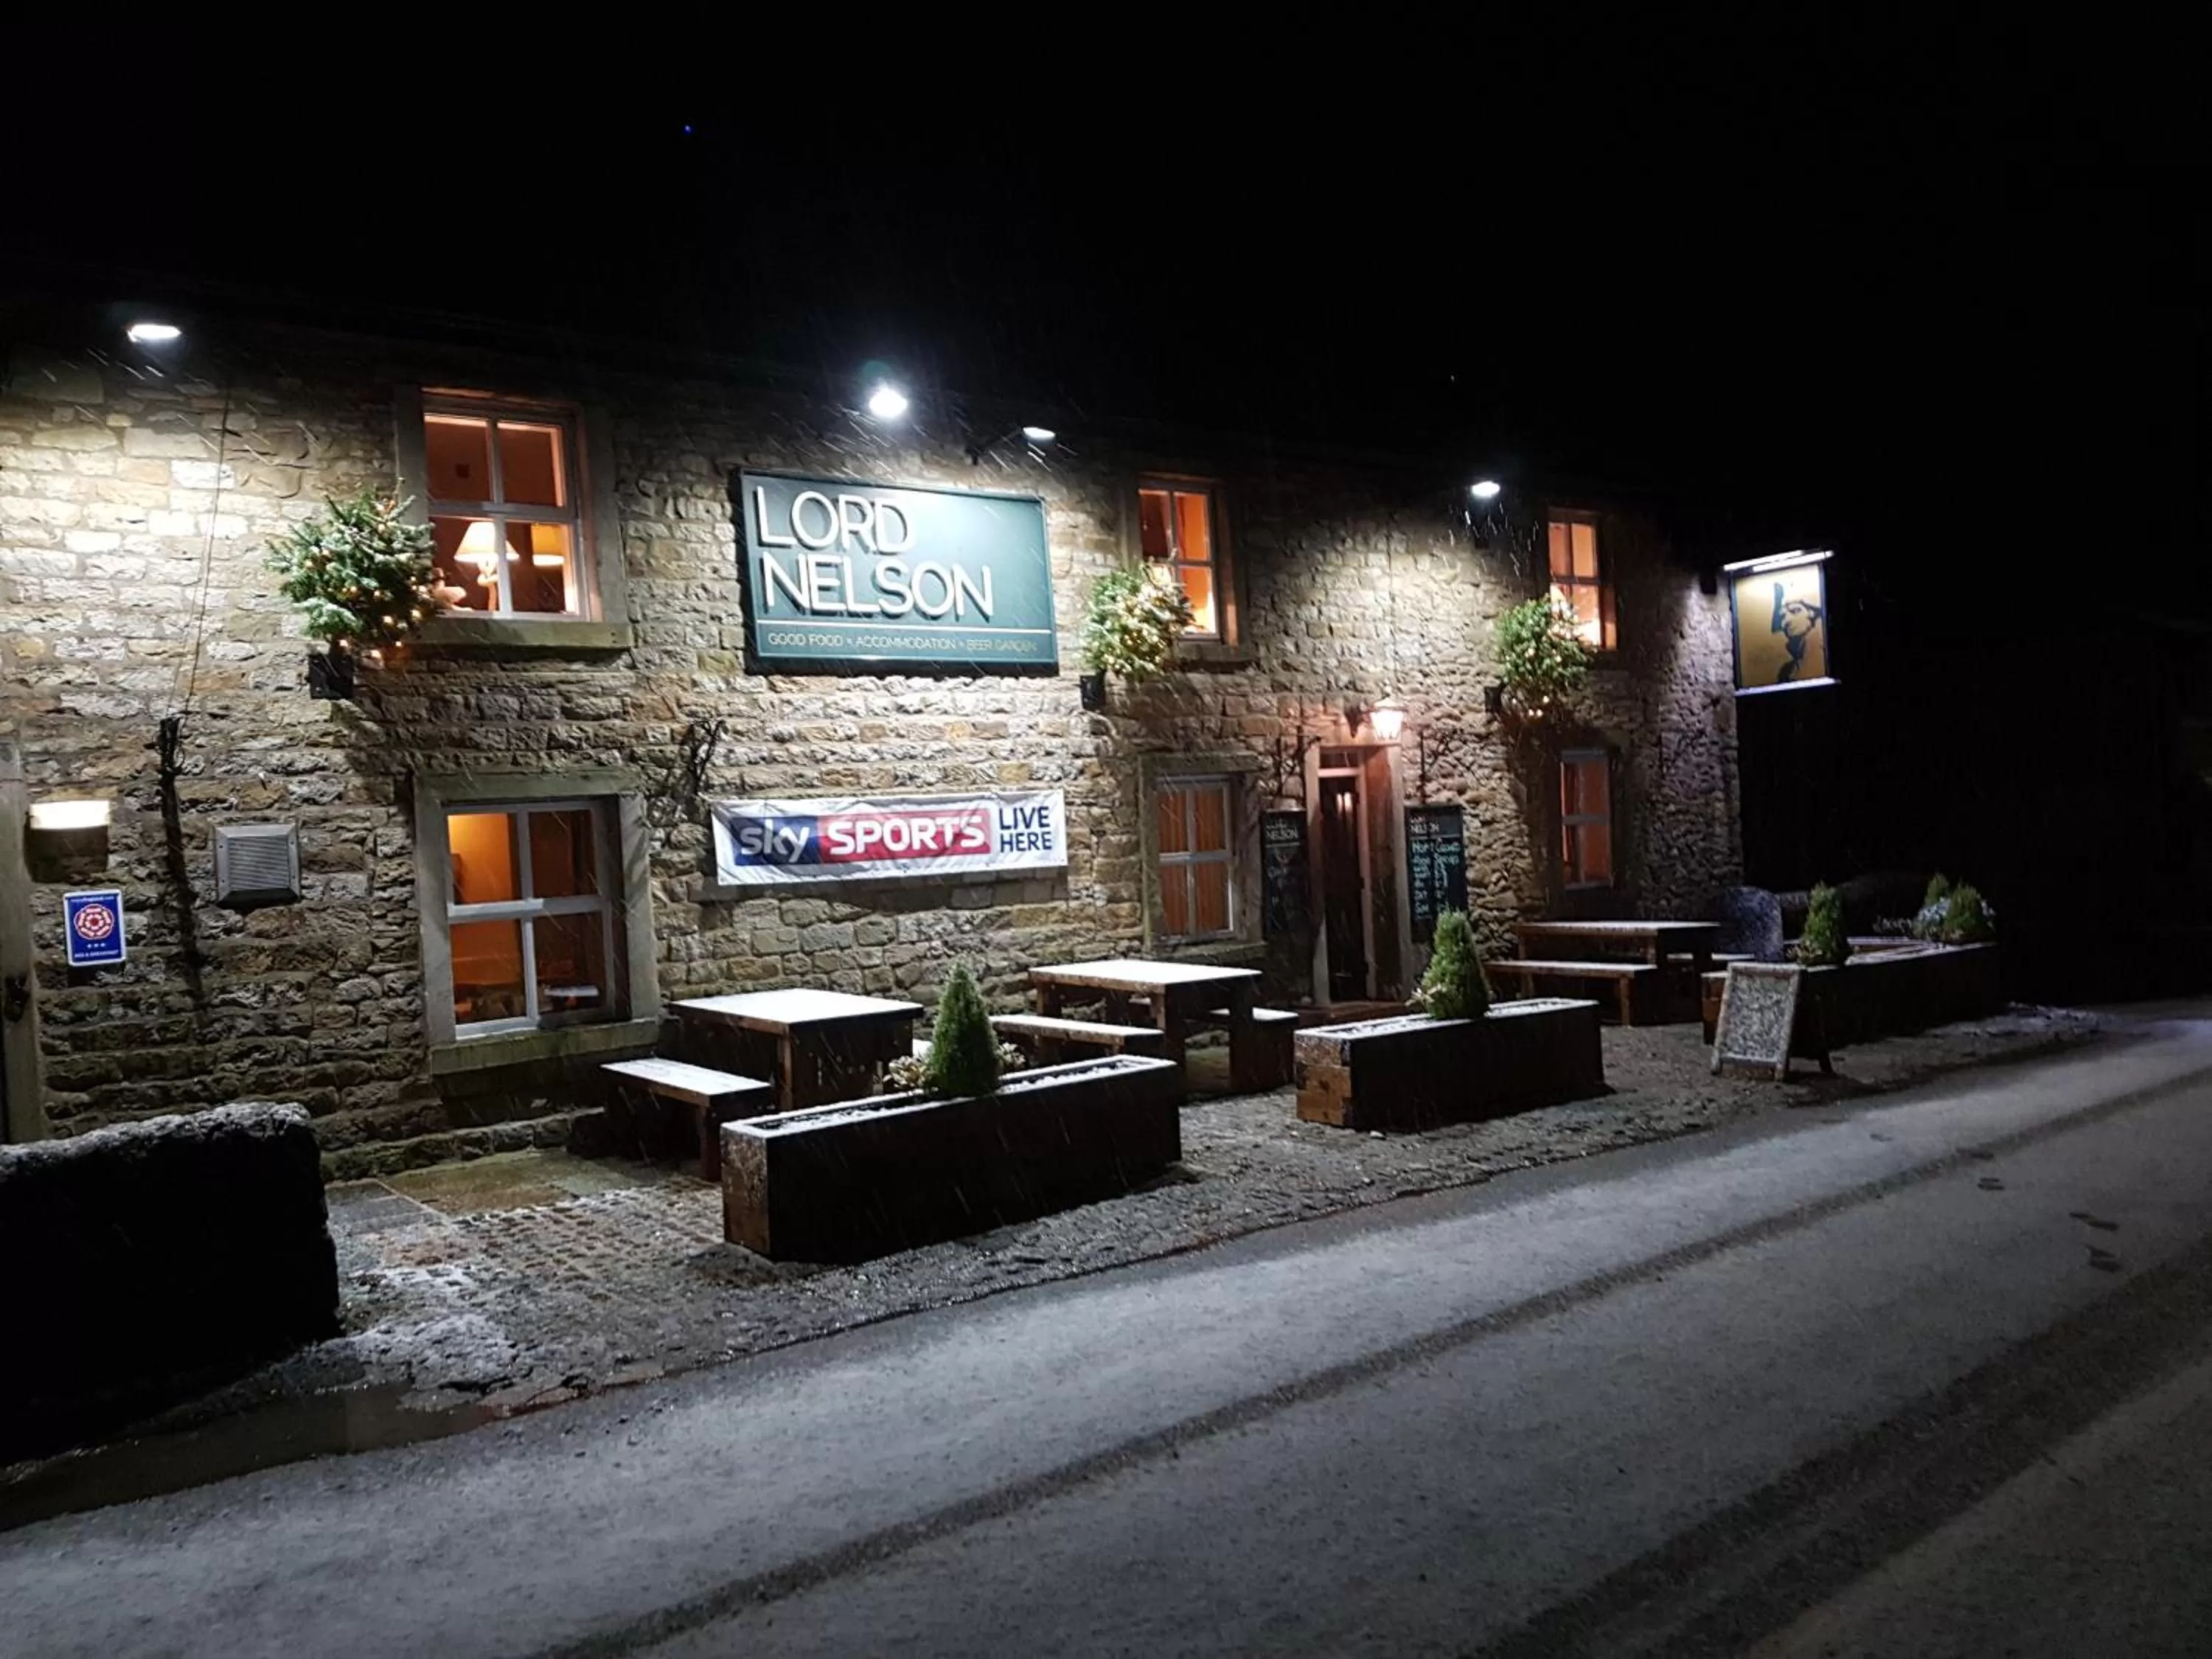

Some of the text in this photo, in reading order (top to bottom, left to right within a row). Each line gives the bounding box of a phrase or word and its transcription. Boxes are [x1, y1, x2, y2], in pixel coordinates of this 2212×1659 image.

[756, 485, 917, 554] LORD
[762, 551, 994, 618] NELSON
[768, 633, 807, 646] GOOD
[810, 634, 844, 647] FOOD
[855, 635, 956, 650] ACCOMMODATION
[998, 806, 1050, 831] LIVE
[740, 815, 985, 863] sky SPORTS
[999, 831, 1053, 853] HERE
